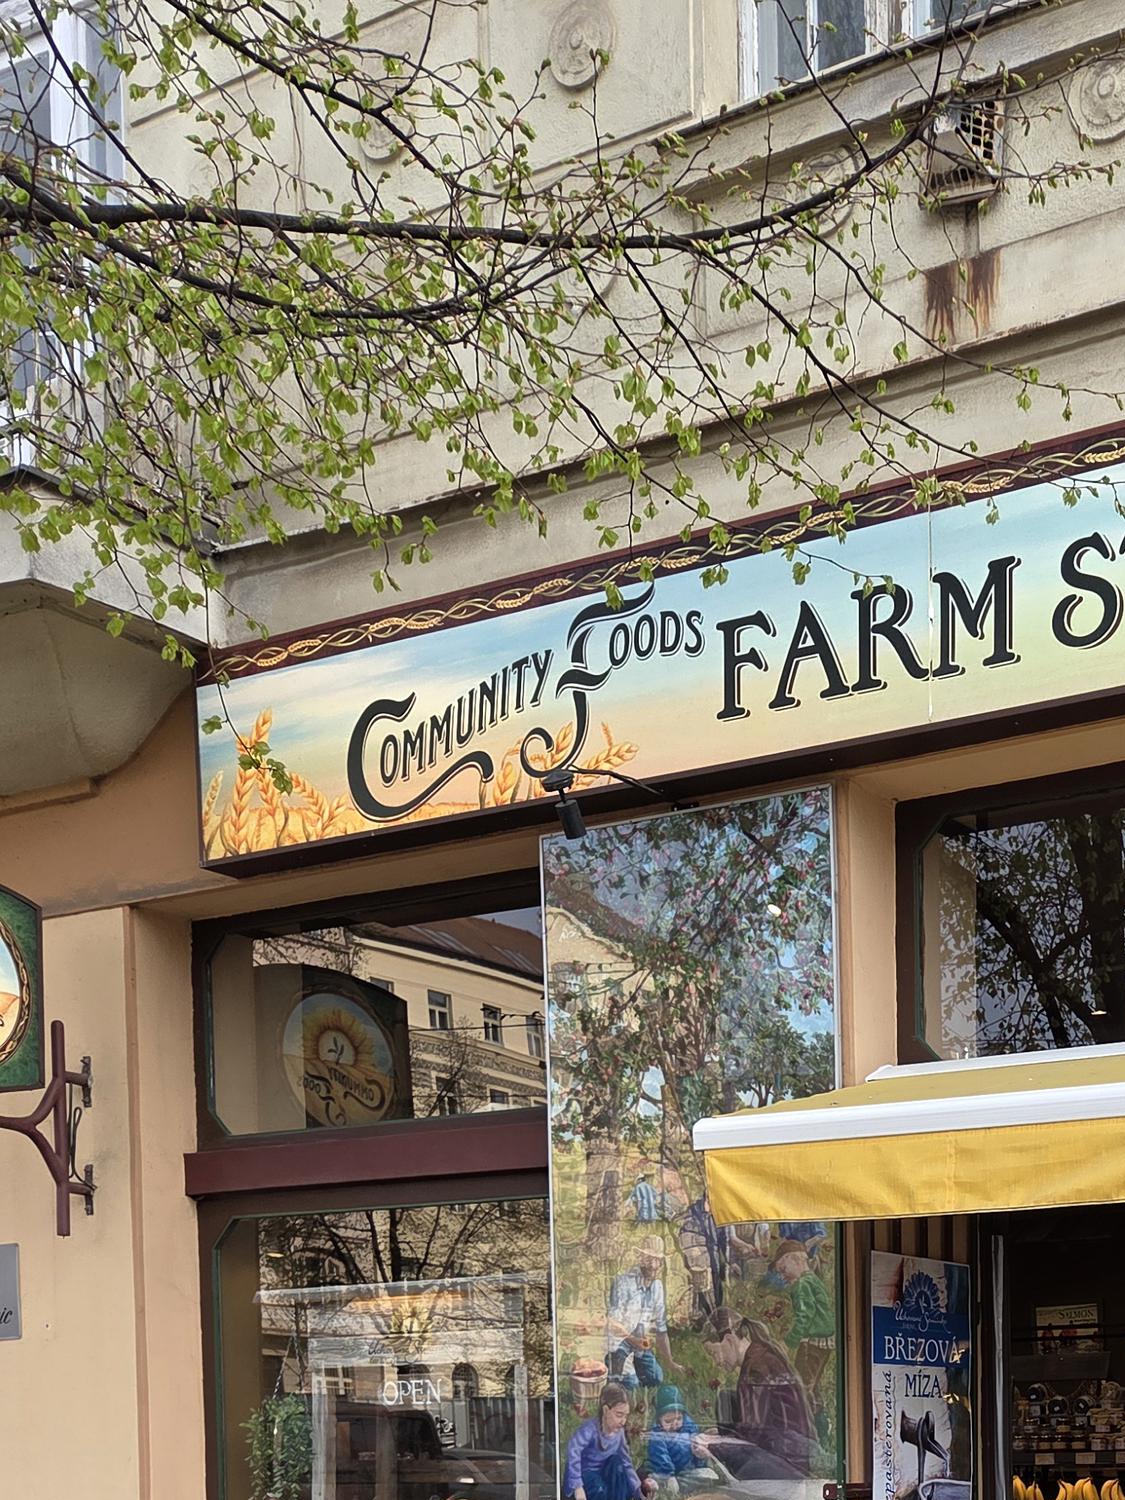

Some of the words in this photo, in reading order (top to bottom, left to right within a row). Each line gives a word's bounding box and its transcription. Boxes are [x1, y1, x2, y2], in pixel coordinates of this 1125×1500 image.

[347, 647, 553, 823] COMMUNITY
[521, 584, 706, 776] FOODS
[715, 554, 1022, 722] FARM
[884, 1332, 960, 1364] BŘEZOVÁ
[382, 1379, 442, 1405] OPEN
[904, 1369, 943, 1398] MÍZA
